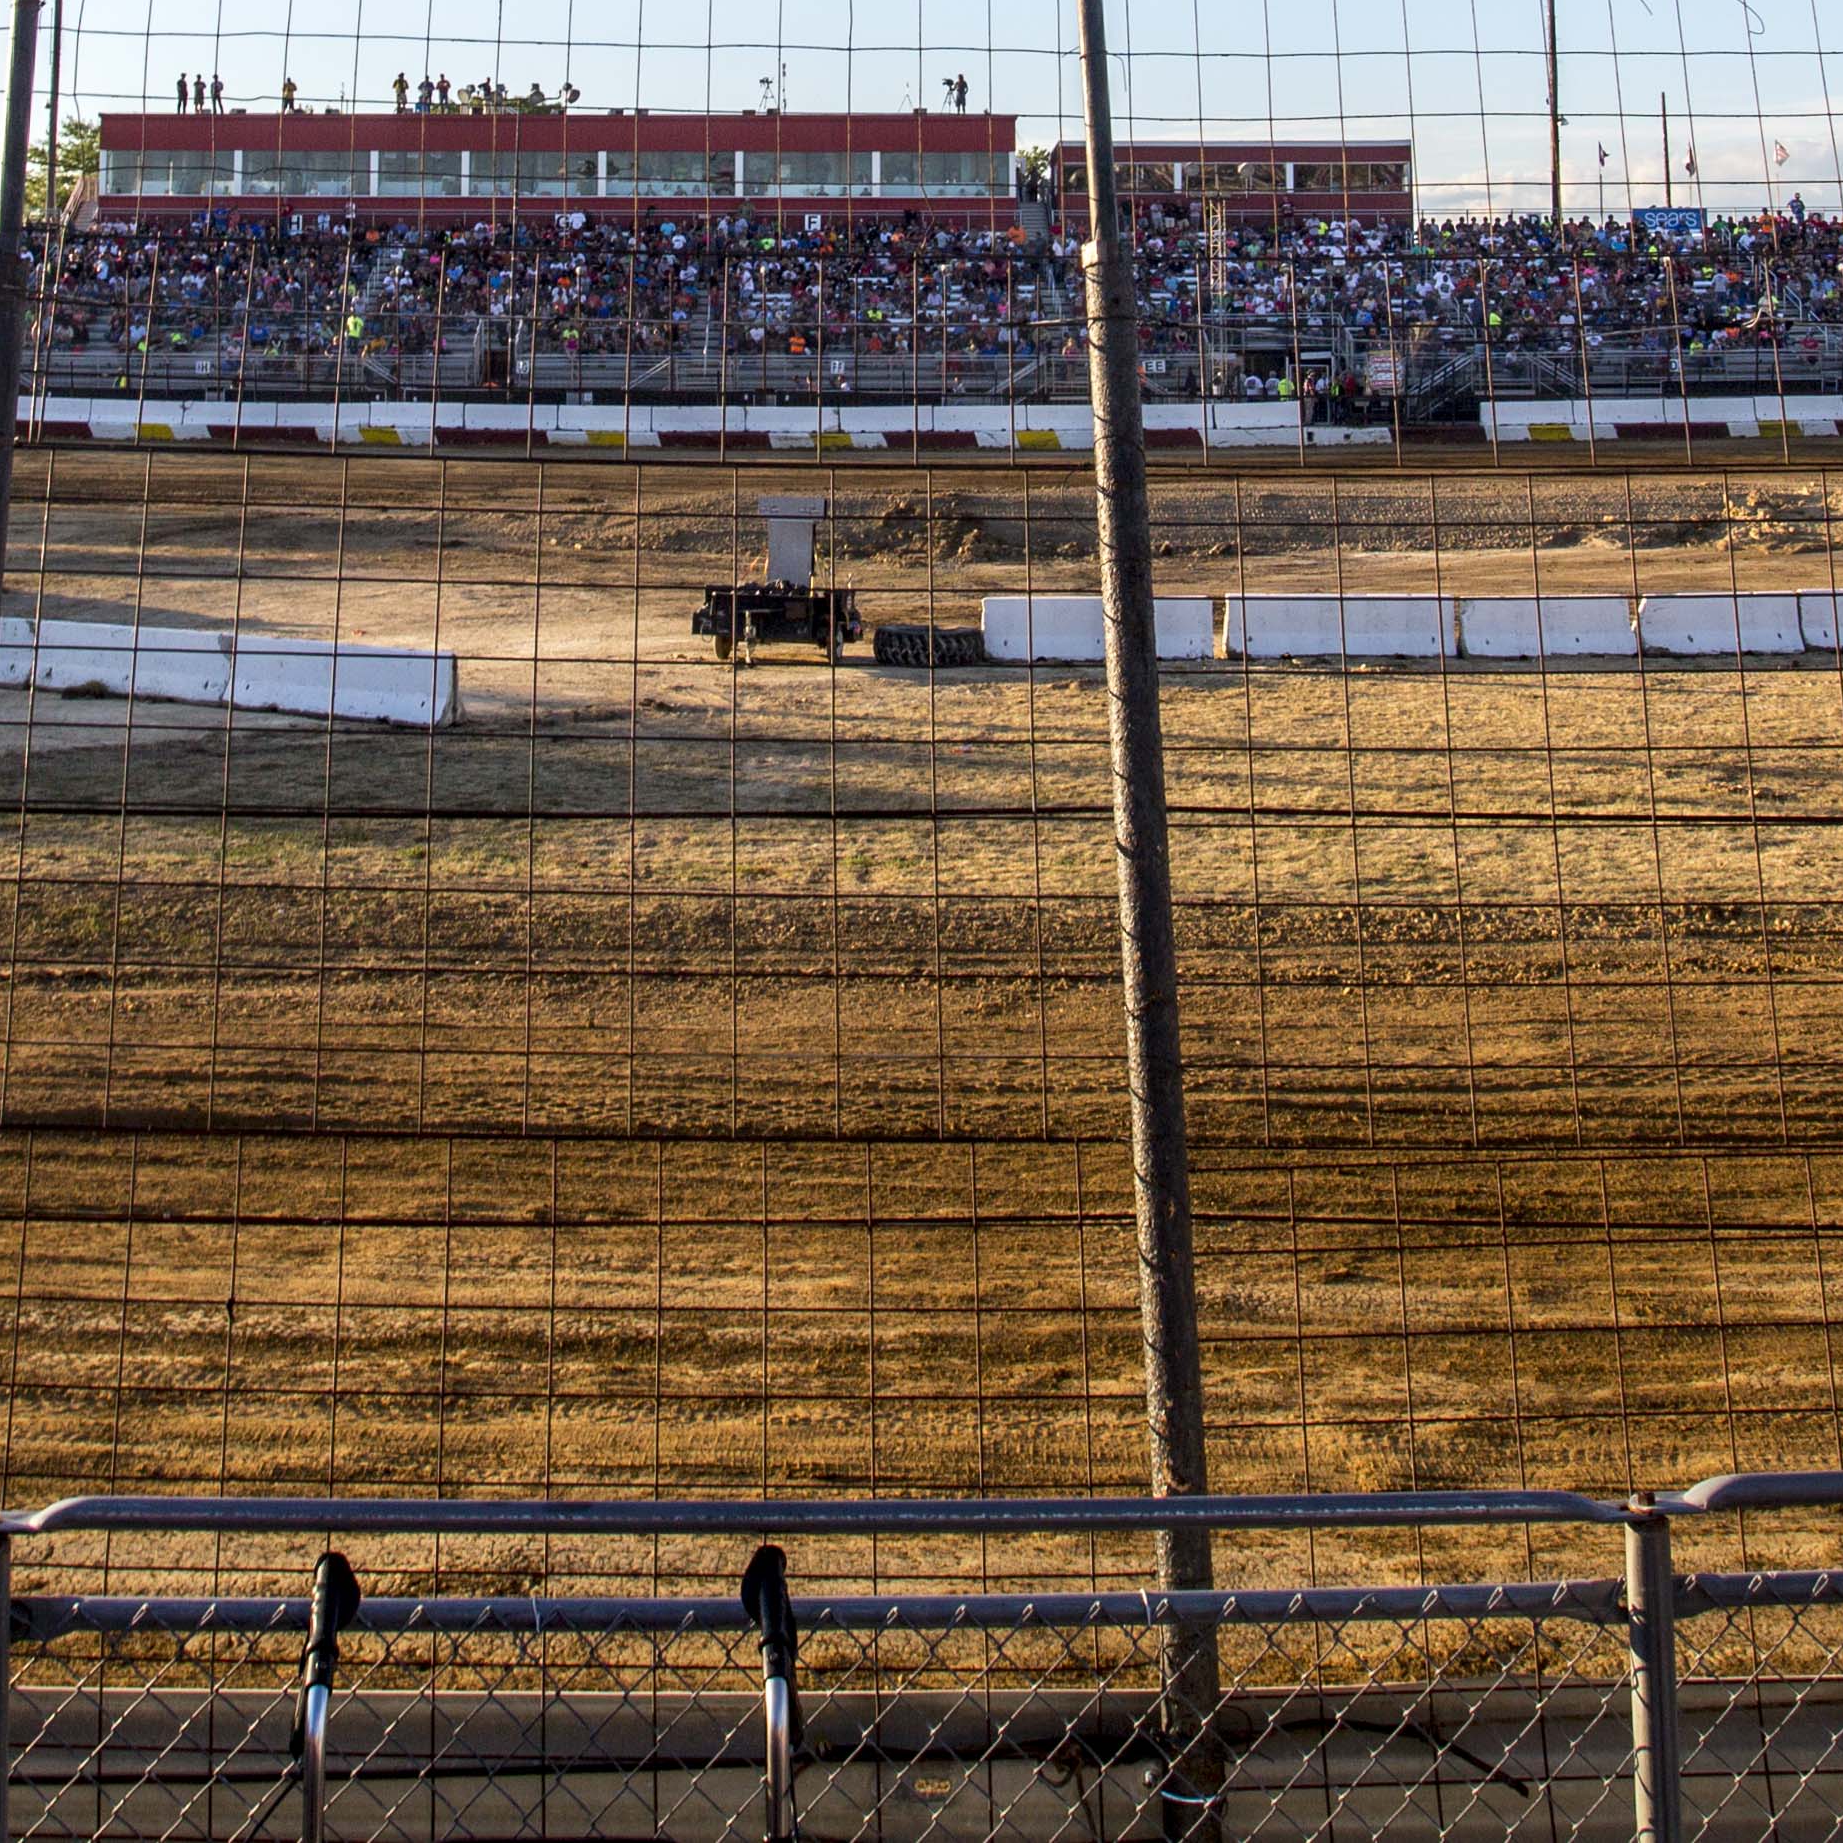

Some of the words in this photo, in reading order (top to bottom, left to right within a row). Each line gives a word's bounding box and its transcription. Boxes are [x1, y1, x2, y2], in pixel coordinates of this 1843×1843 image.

[808, 215, 818, 230] F
[1645, 211, 1698, 228] sears
[1145, 361, 1164, 372] EE
